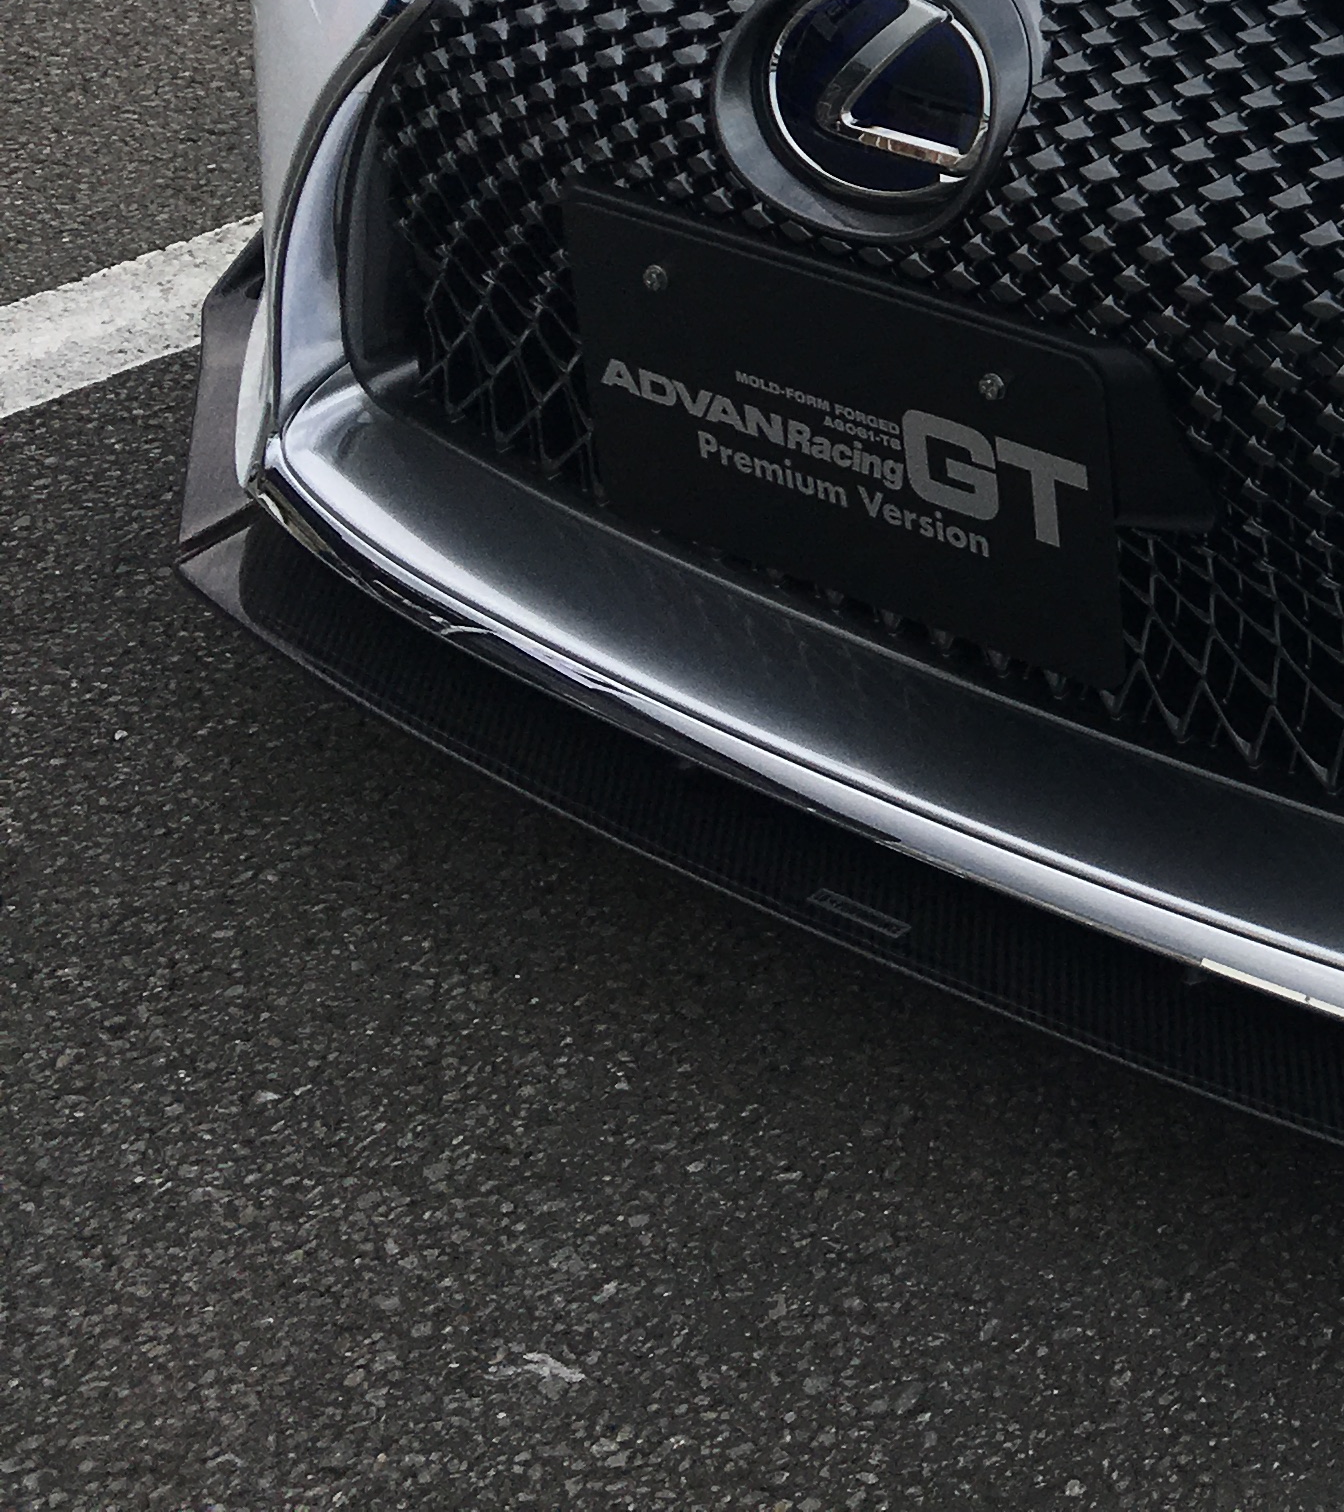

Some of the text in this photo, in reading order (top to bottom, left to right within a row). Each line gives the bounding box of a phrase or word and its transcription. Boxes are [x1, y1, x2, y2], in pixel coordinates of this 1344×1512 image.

[735, 370, 900, 435] MOLD-FORM FORGED
[697, 430, 990, 558] Premium Version
[902, 408, 1089, 548] GT
